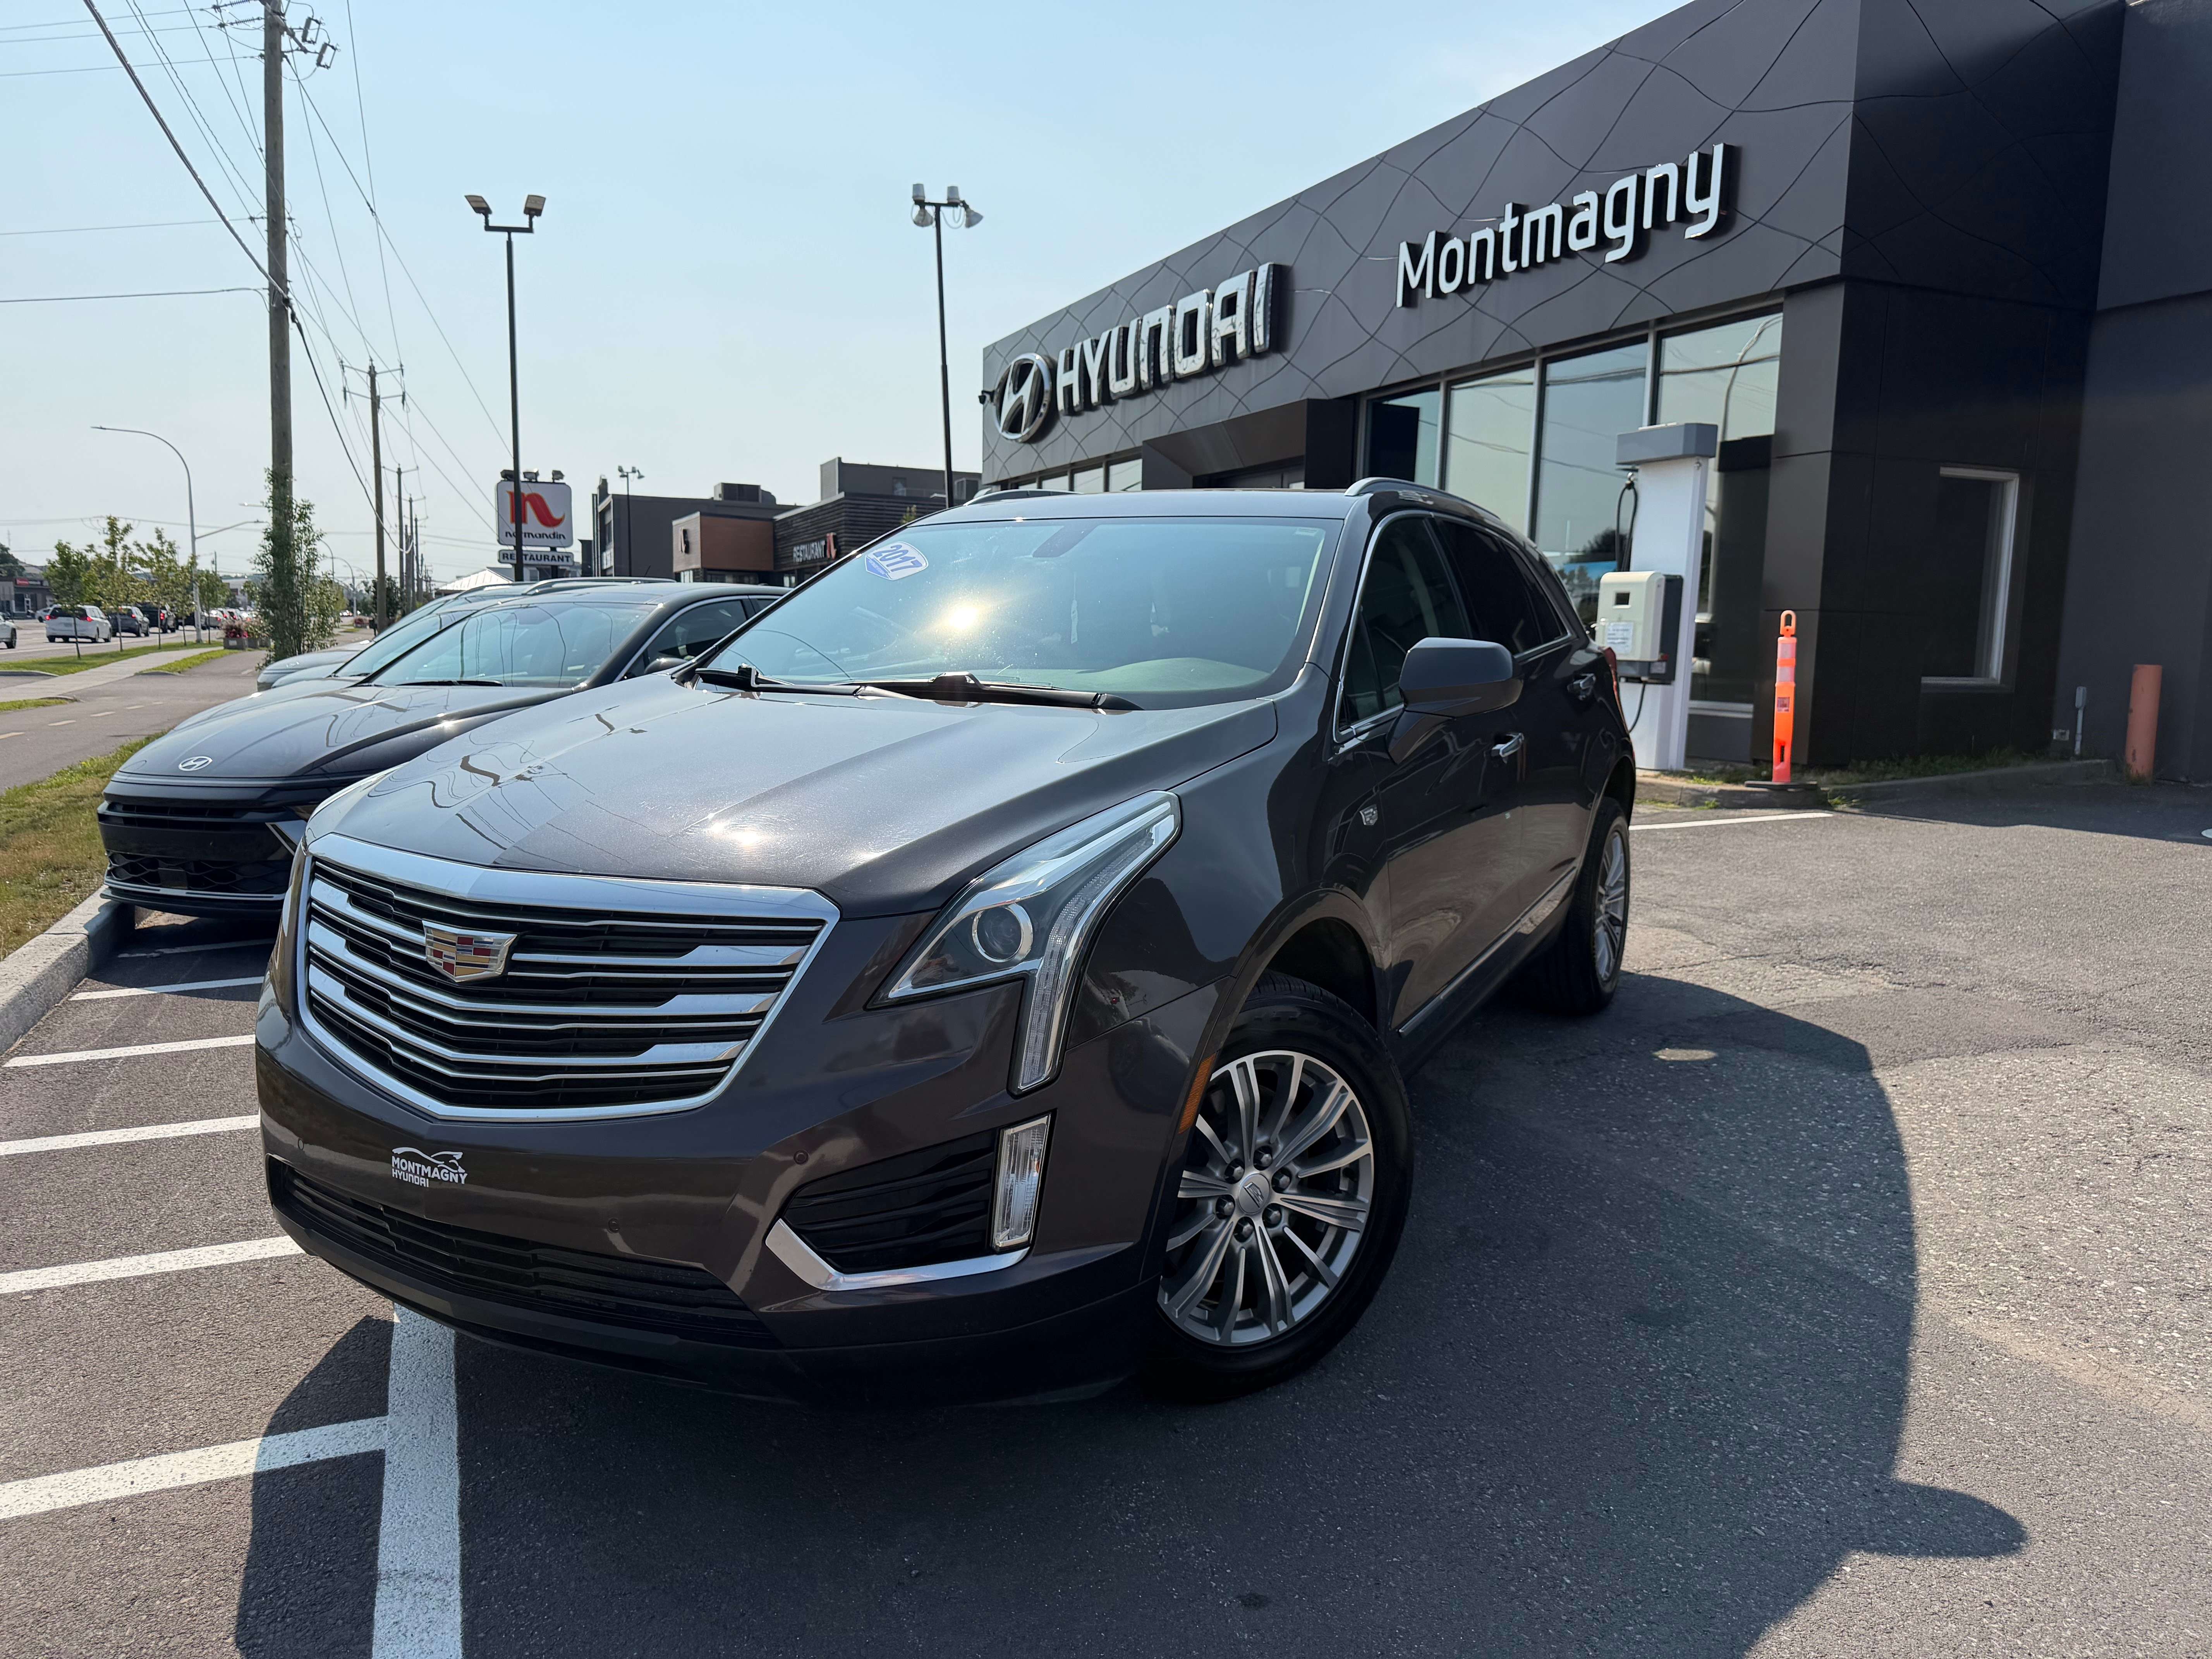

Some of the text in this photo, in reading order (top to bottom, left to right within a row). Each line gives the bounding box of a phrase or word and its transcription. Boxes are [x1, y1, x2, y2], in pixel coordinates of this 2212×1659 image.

[1396, 143, 1725, 308] Montmagny
[1056, 262, 1276, 416] HYUNDAI
[505, 531, 566, 539] nomandin
[502, 553, 571, 562] RETAURANT
[873, 544, 923, 572] 2017
[392, 1156, 468, 1184] MONTMAGNY
[392, 1168, 429, 1188] HYUNDAI
